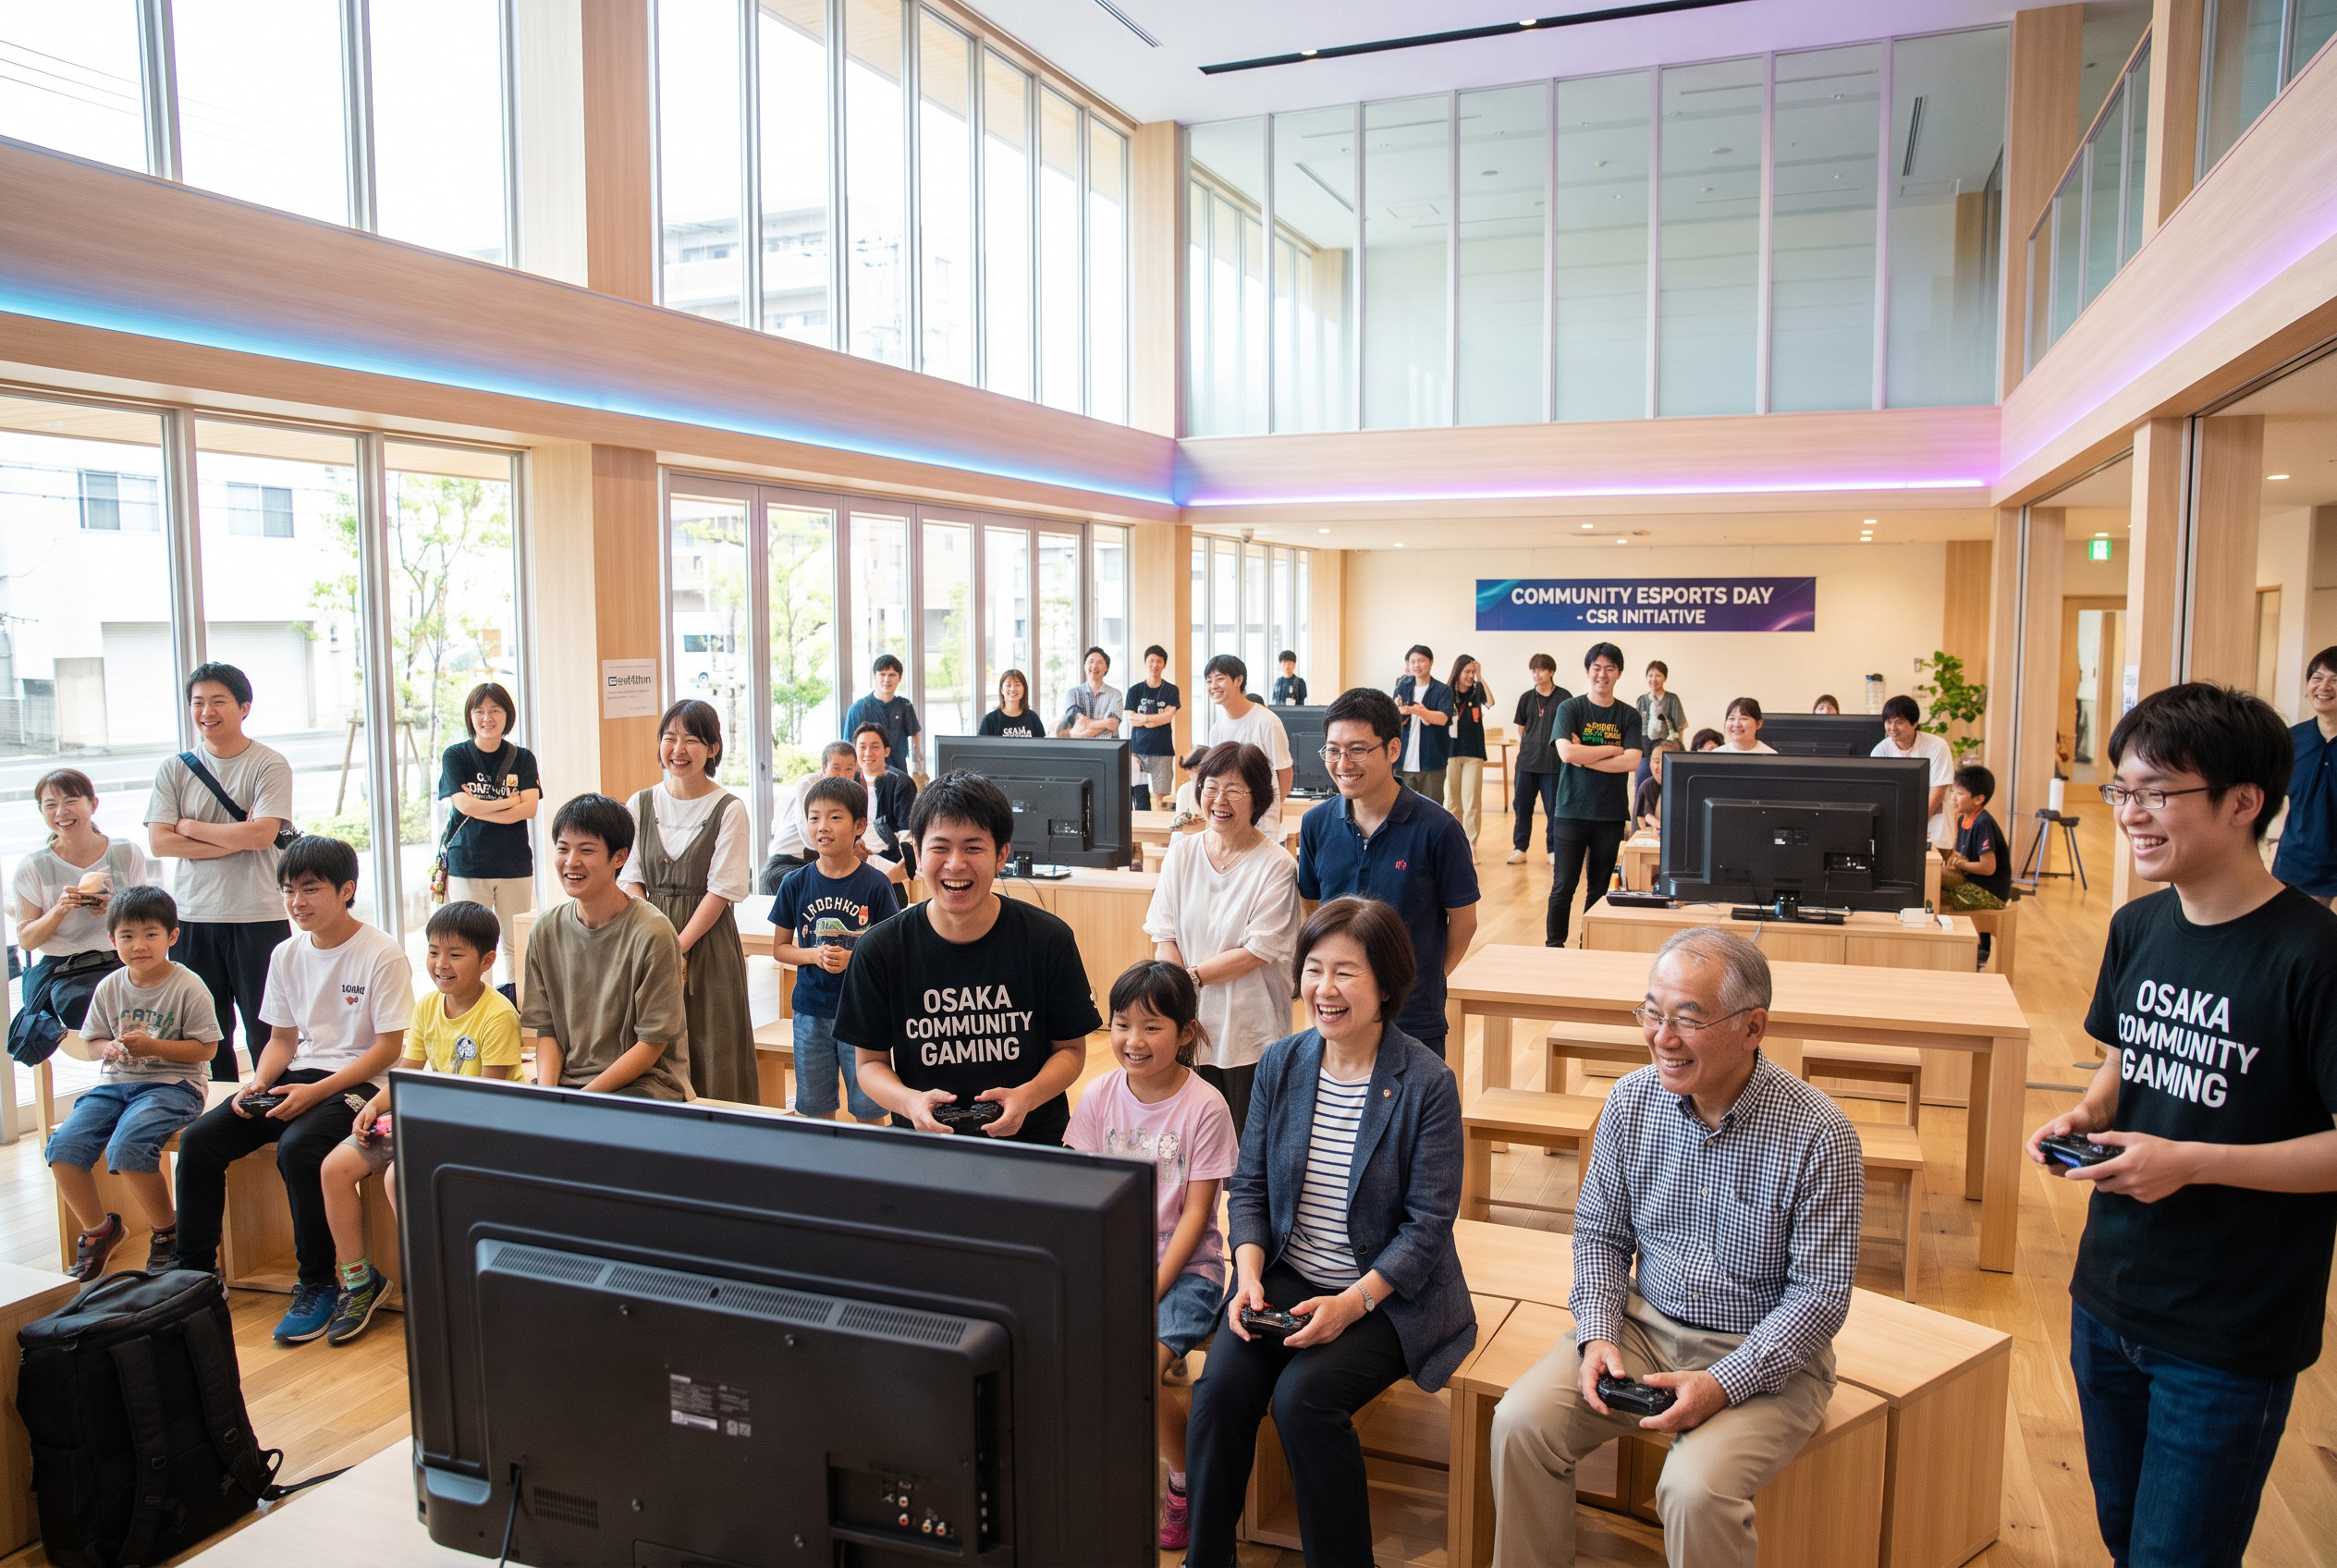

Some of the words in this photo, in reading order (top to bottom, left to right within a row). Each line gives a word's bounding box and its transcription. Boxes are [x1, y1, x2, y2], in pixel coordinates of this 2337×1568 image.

[1511, 587, 1633, 605] COMMUNITY
[1636, 587, 1728, 605] ESPORTS
[1732, 587, 1774, 605] DAY
[1585, 609, 1619, 624] CSR
[1621, 609, 1706, 624] INITIATIVE
[924, 985, 1013, 1013] OSAKA
[2136, 980, 2230, 1034] OSAKA
[906, 1011, 1033, 1039] COMMUNITY
[921, 1036, 1021, 1066] GAMING
[2119, 1013, 2260, 1074] COMMUNITY
[2122, 1048, 2228, 1108] GAMING
